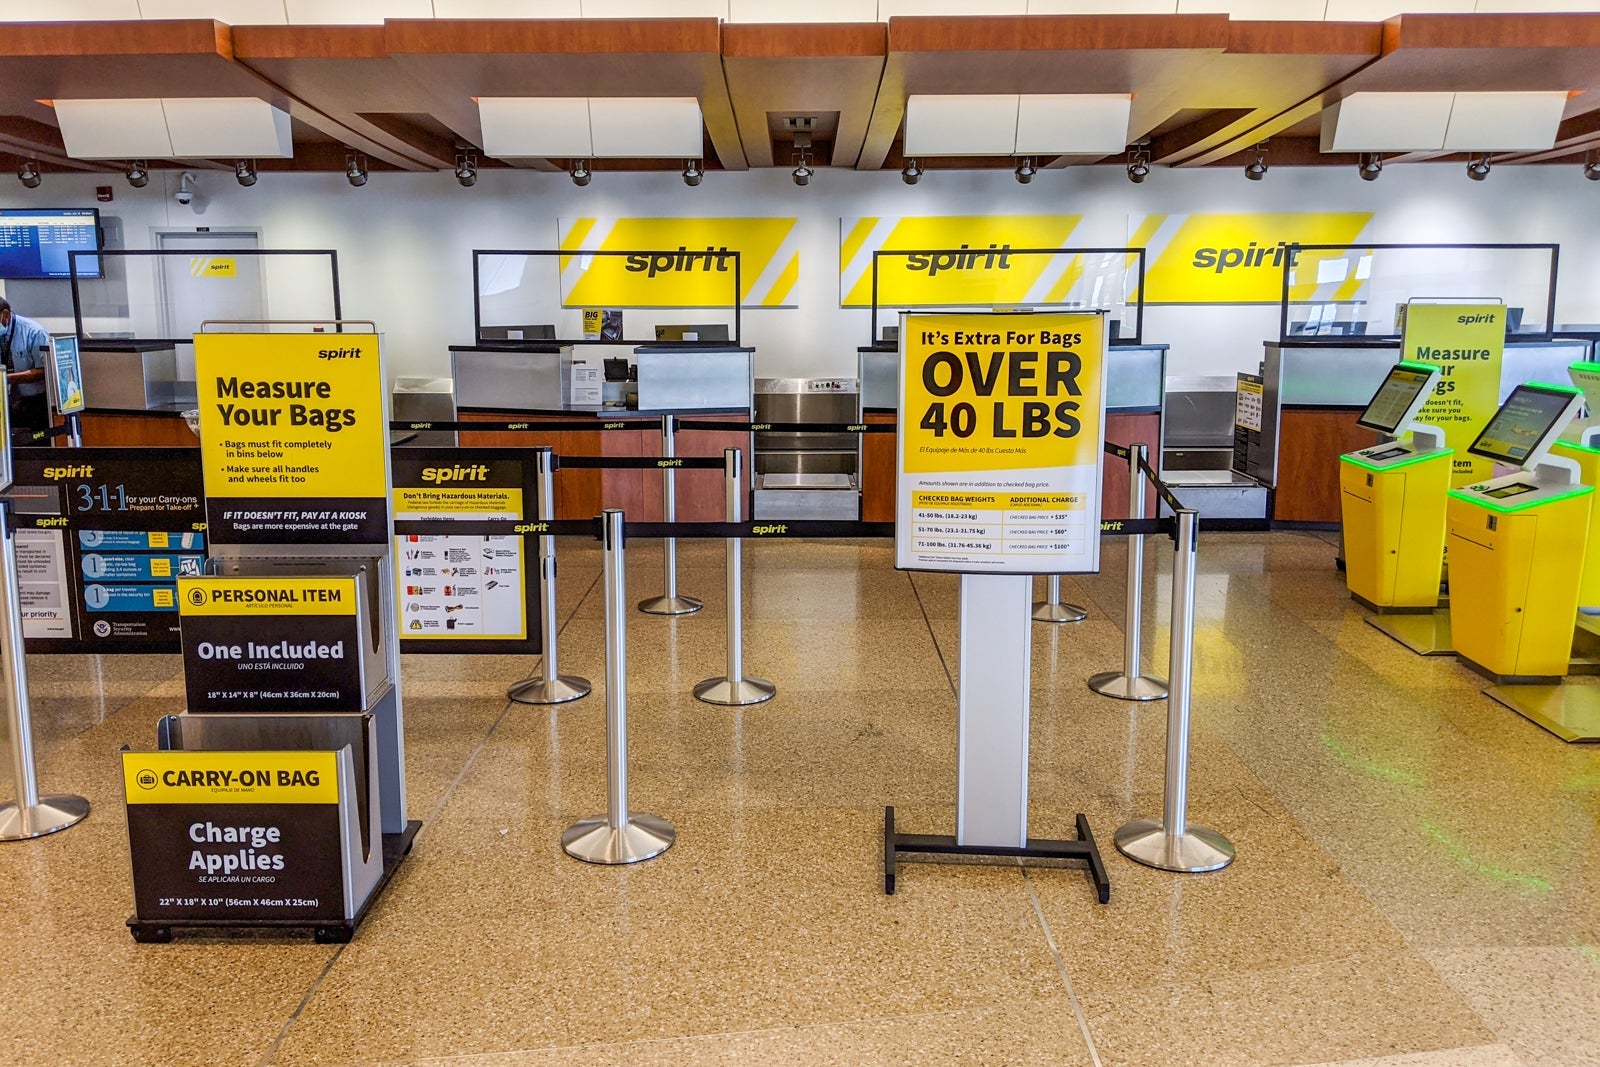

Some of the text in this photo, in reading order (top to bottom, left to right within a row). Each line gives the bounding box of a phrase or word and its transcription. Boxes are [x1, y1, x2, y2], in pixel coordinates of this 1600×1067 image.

[625, 247, 729, 277] spirit
[906, 244, 1012, 276] spirit
[1193, 242, 1301, 273] spirit
[1457, 314, 1495, 325] spirit
[954, 331, 1000, 344] Extra
[1006, 332, 1035, 344] For
[1040, 331, 1081, 348] Bags
[318, 348, 361, 360] spirit
[1417, 347, 1490, 360] Measure
[922, 351, 1082, 397] OVER
[216, 377, 330, 398] Measure
[217, 404, 356, 432] Your Bags
[920, 402, 1081, 438] 40 LBS
[225, 441, 245, 449] Bags
[284, 440, 332, 449] completely
[657, 459, 683, 467] spirit
[43, 465, 94, 480] spirit
[422, 465, 487, 484] spirit
[77, 484, 128, 511] 3-1-1
[159, 495, 197, 504] Carry-ons
[36, 518, 67, 528] spirit
[224, 511, 367, 521] IF IT DOESN'T FIT, PAY AT A KIOSK
[233, 523, 250, 531] Bags
[285, 523, 319, 531] expensive
[514, 523, 548, 534] spirit
[752, 524, 788, 534] spirit
[212, 589, 341, 603] PERSONAL ITEM
[198, 641, 344, 660] One Included
[254, 662, 271, 670] ESTÁ
[260, 691, 282, 700] (46cm
[317, 692, 340, 700] 20cm)
[163, 770, 320, 787] CARRY-ON BAG
[189, 822, 281, 848] Charge
[188, 849, 285, 874] Applies
[225, 898, 251, 907] (56cm
[292, 898, 319, 907] 25cm)
